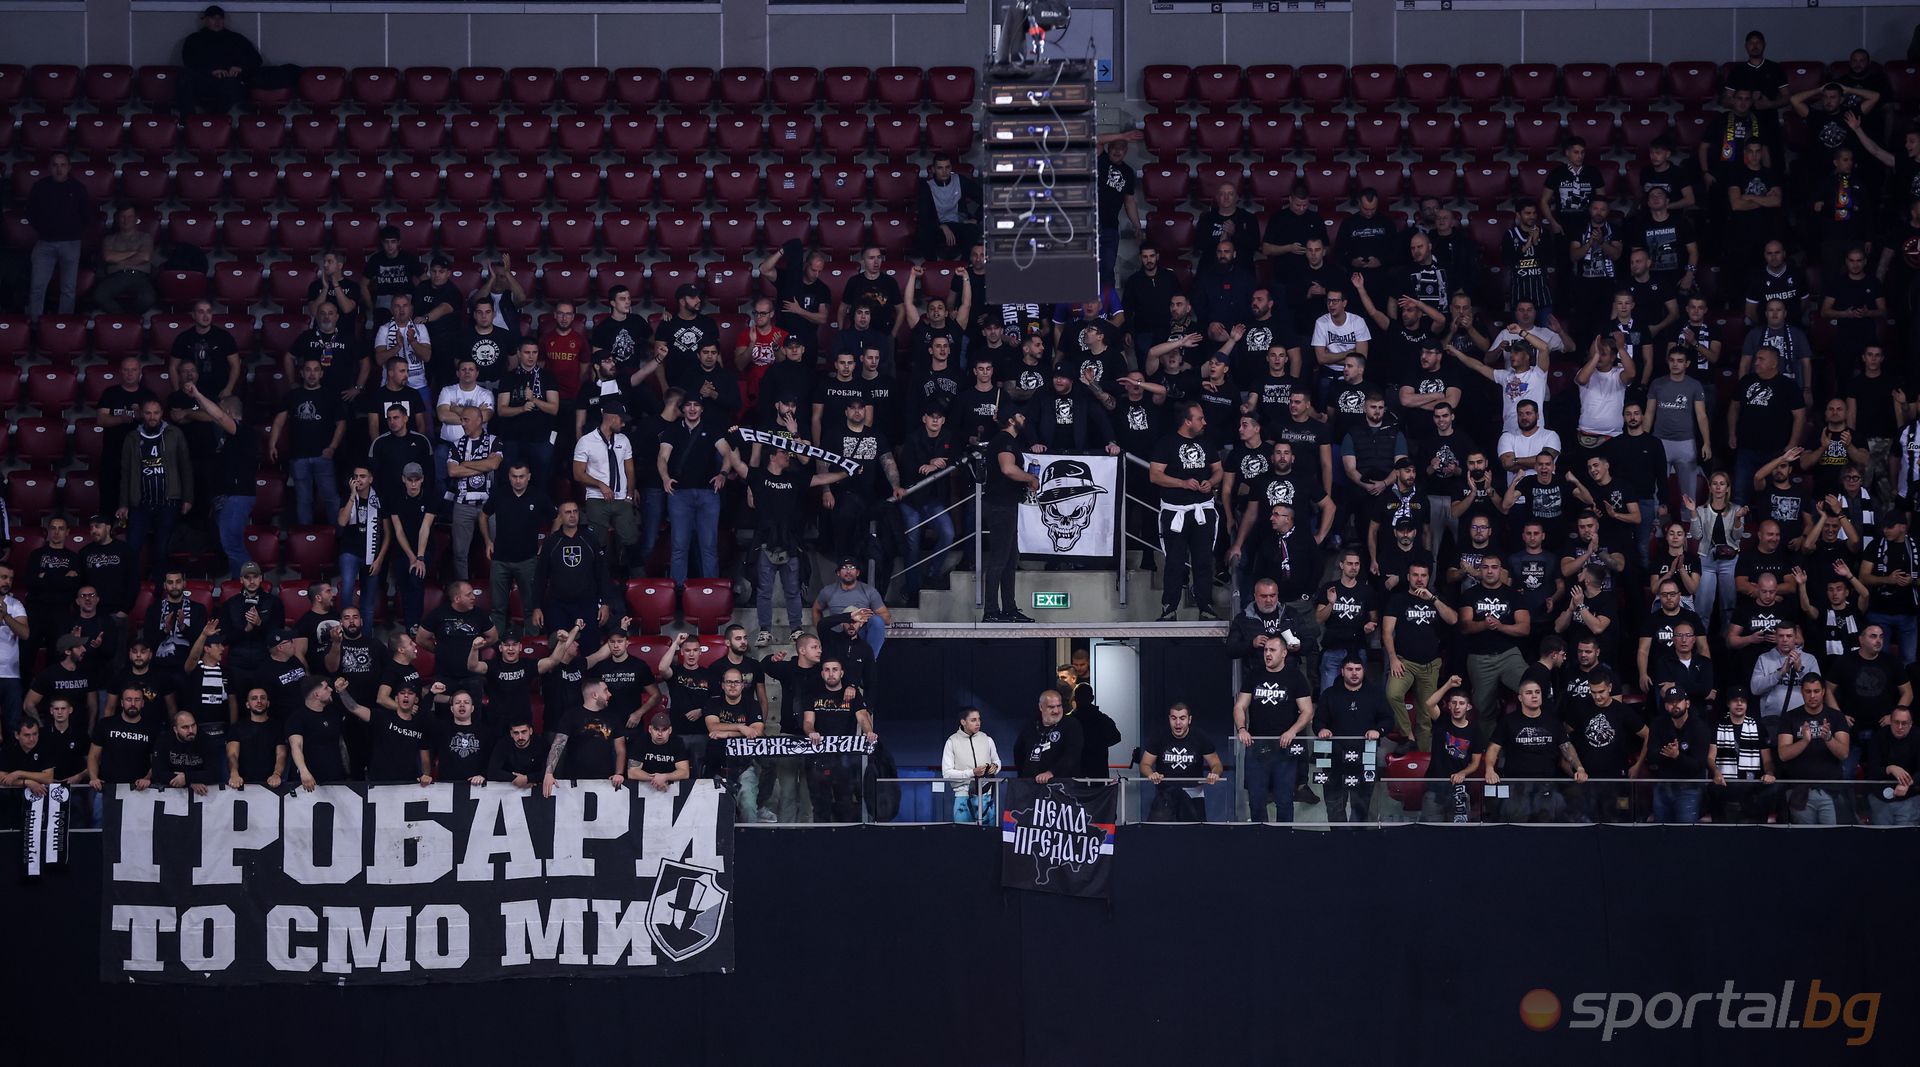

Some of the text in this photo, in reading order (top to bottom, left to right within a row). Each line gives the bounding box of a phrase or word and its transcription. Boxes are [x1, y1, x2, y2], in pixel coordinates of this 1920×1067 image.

[1528, 268, 1542, 276] NIS
[1765, 289, 1797, 302] WINBET
[827, 388, 862, 398] ГРОБАРИ
[150, 446, 159, 457] 4
[1036, 594, 1065, 606] EXIT
[1333, 603, 1361, 613] ПИРОТ
[1477, 603, 1507, 611] ПИРОТ
[1408, 610, 1436, 618] ПИРОТ
[498, 669, 525, 681] РОБАРИ
[55, 679, 89, 689] ГРОБАРИ
[1255, 689, 1285, 698] ПИРОТ
[110, 730, 149, 743] ГРОБАРИ
[1164, 754, 1194, 763] ПИРОТ
[1031, 797, 1088, 834] НЕМА
[112, 777, 726, 886] ГРОБАРИ
[1013, 826, 1100, 866] ПРЕДАЈЕ
[111, 898, 658, 974] ТО СМО МИ
